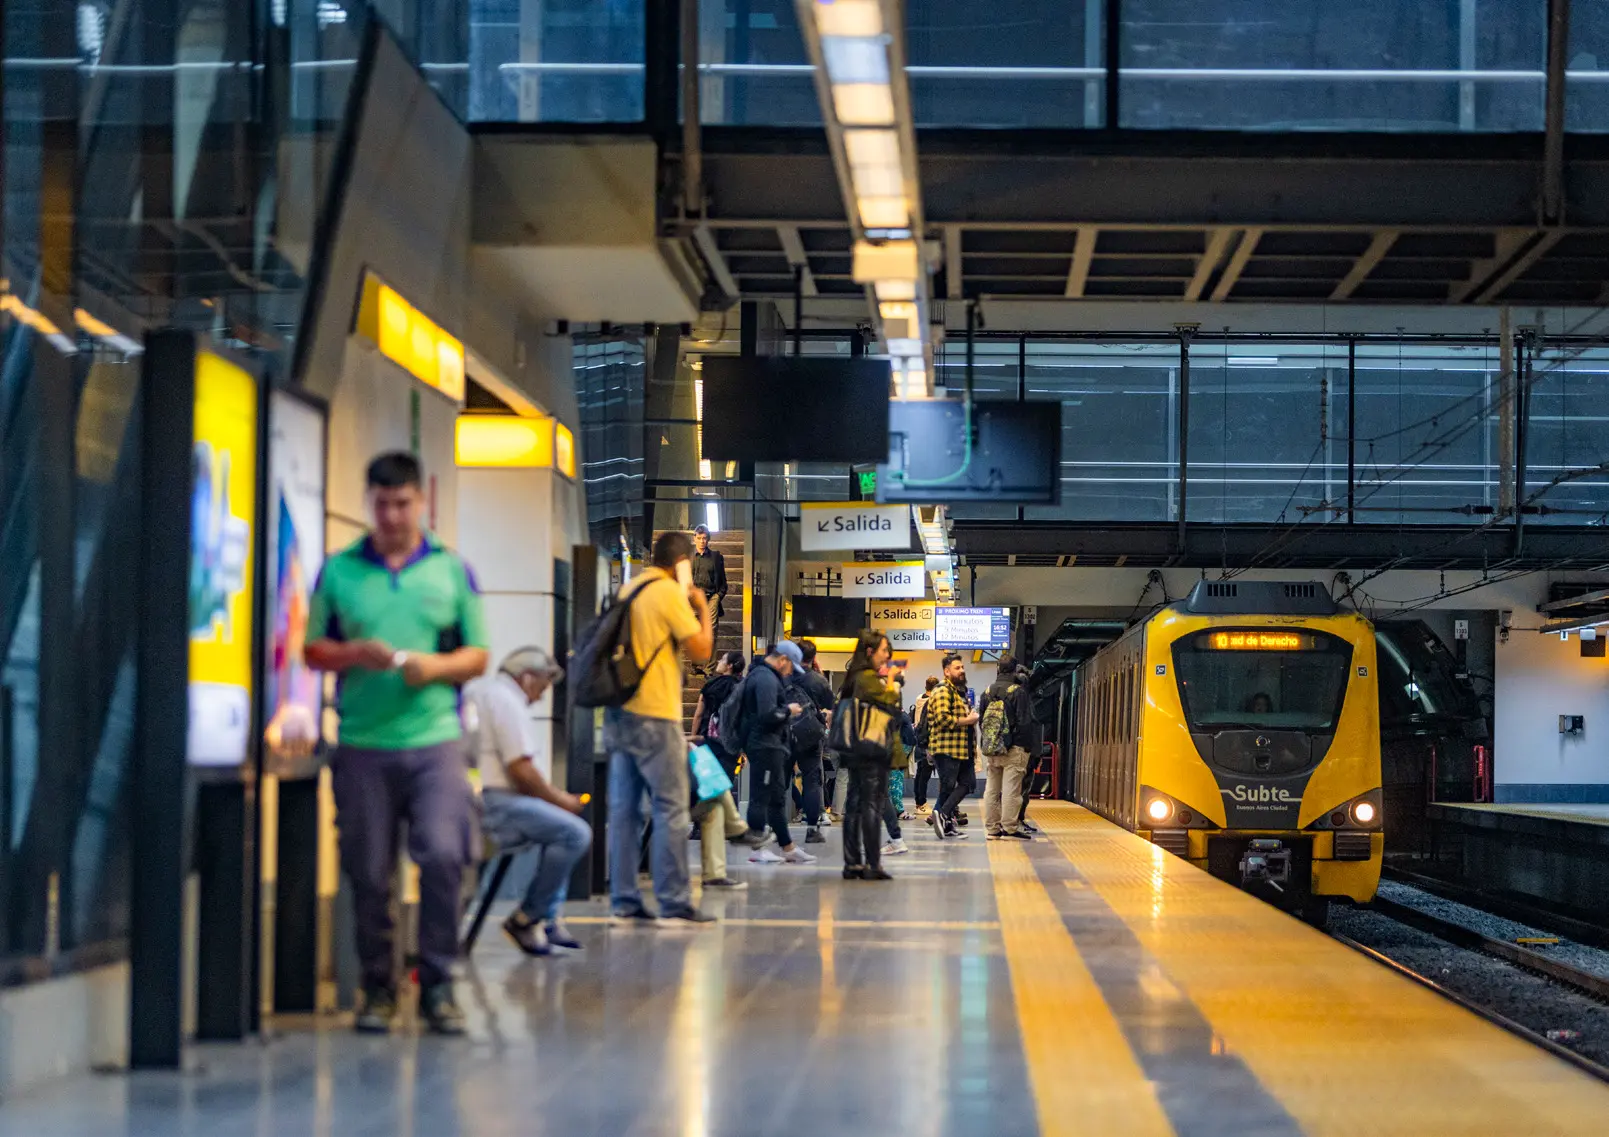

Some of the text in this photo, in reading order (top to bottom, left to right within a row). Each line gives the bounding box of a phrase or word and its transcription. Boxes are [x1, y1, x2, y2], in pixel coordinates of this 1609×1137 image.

[834, 514, 891, 531] Salida
[867, 571, 911, 585] Salida
[883, 609, 917, 620] Salida
[901, 632, 931, 642] Salida
[1246, 637, 1258, 645] de
[1260, 636, 1299, 645] Derecho
[1235, 784, 1290, 802] Subte
